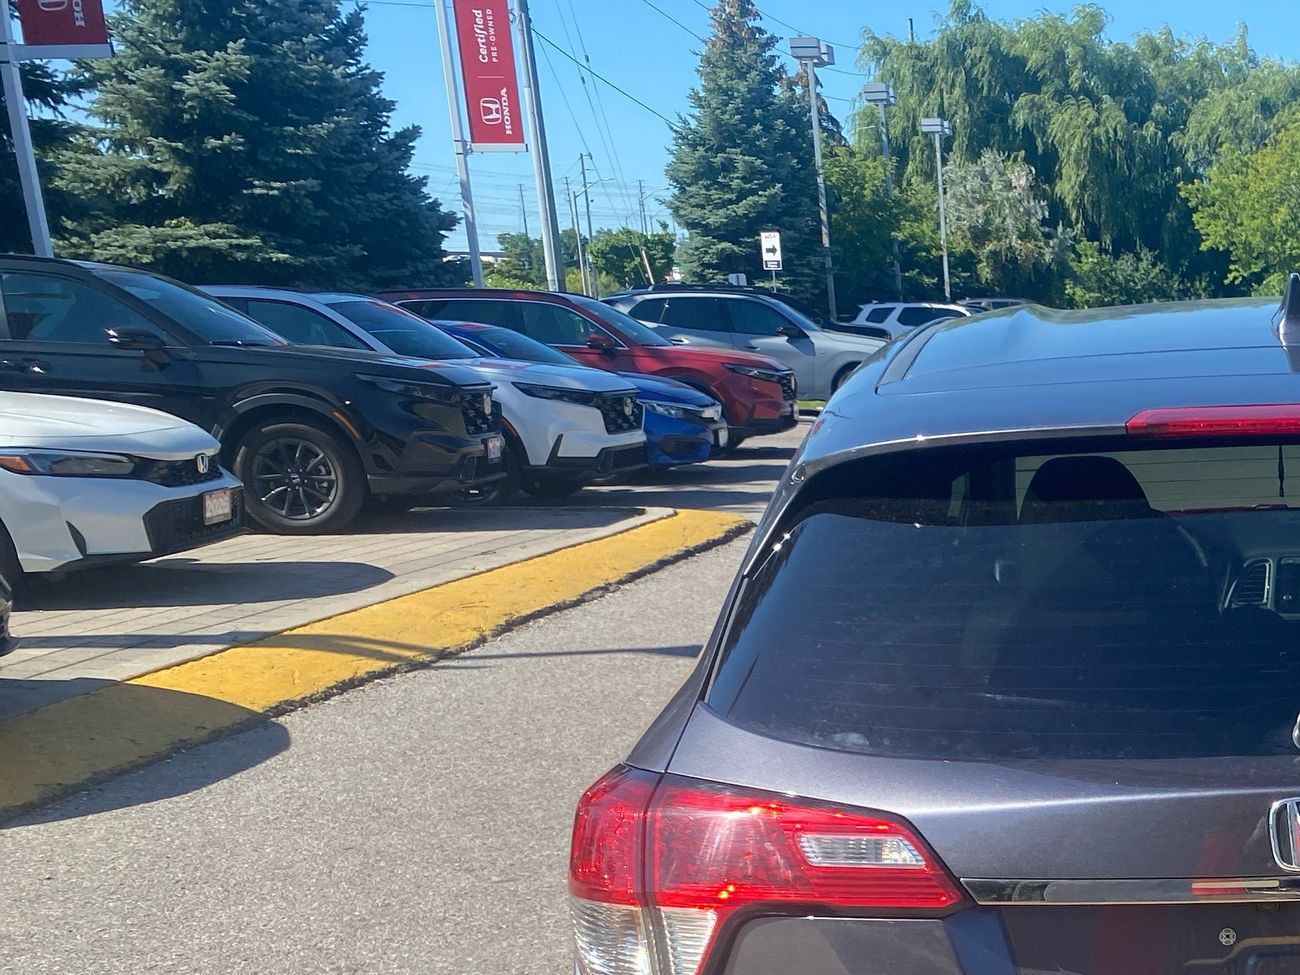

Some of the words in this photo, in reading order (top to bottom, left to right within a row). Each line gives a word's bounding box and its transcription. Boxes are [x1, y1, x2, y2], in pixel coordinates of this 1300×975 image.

[472, 8, 489, 63] Certified
[485, 8, 499, 63] PRE-OWNED
[500, 86, 513, 135] HONDA
